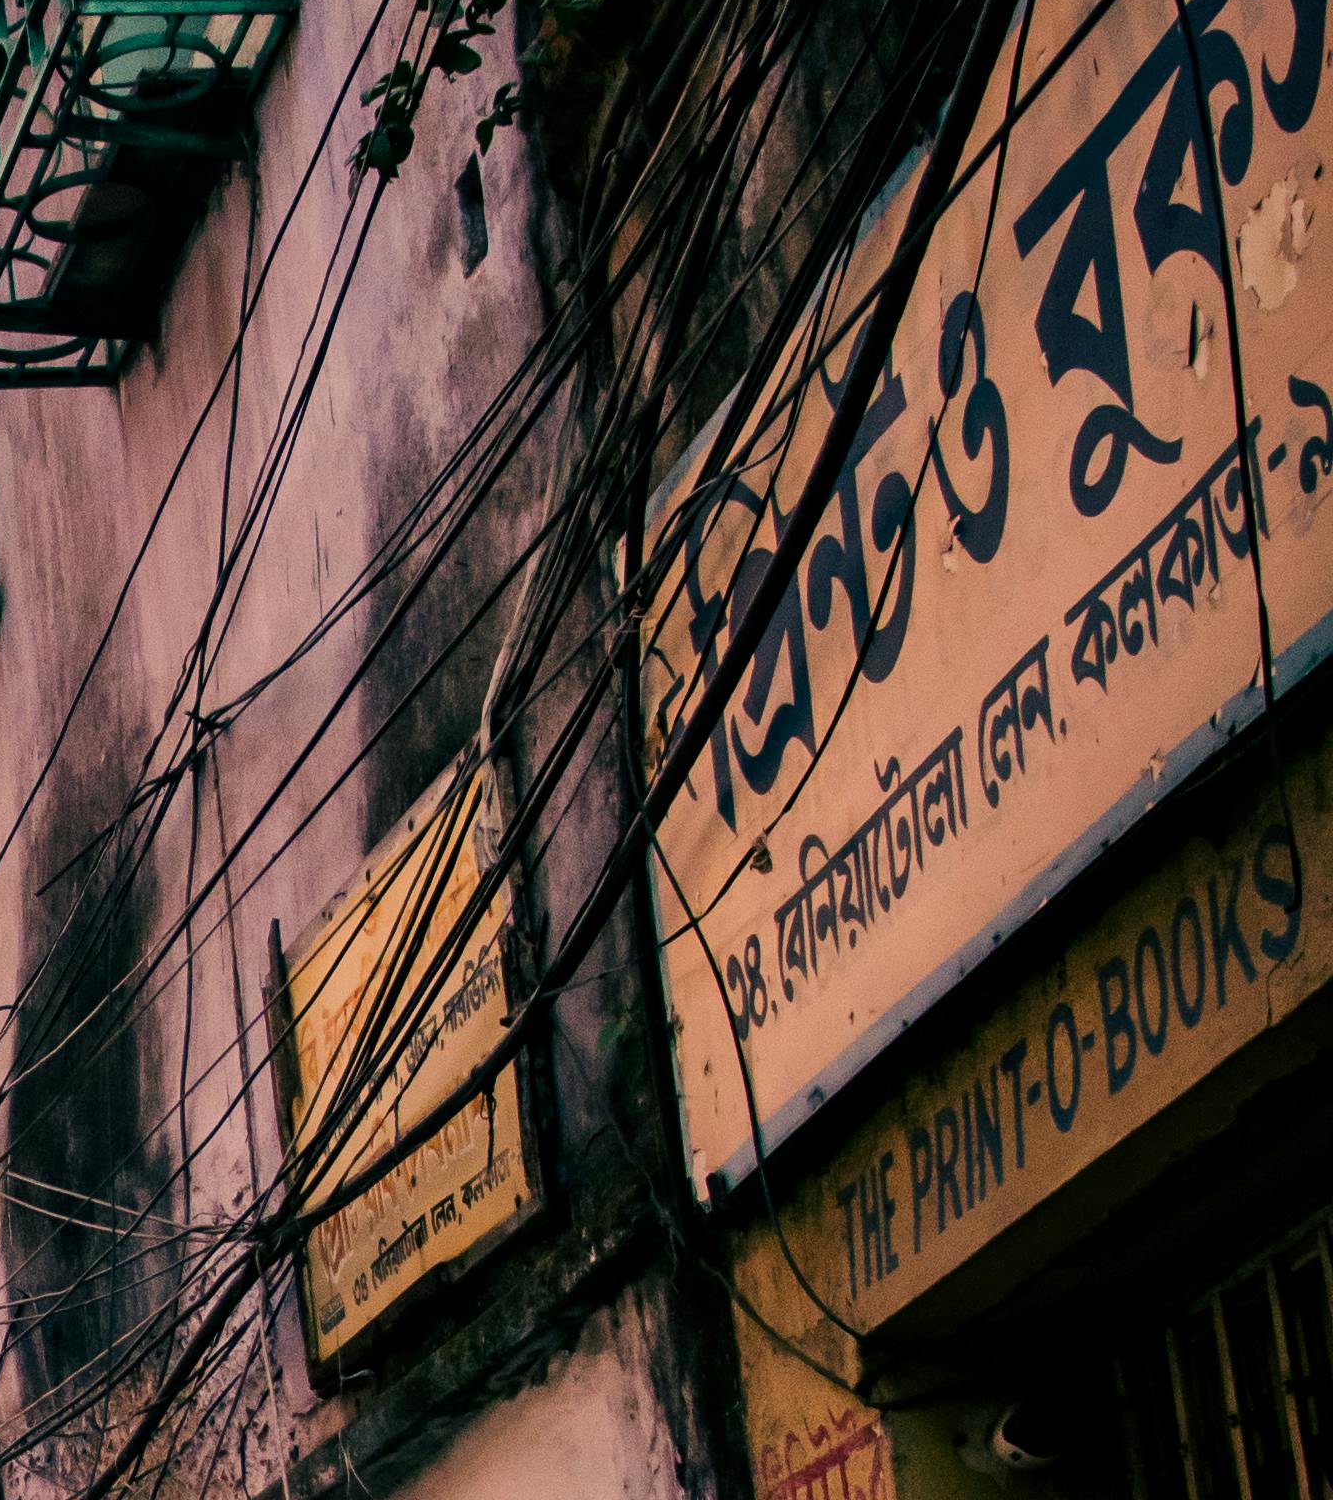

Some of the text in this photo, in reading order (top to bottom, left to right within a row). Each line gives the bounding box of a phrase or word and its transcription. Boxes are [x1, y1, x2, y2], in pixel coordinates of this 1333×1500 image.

[930, 291, 1009, 564] ও
[774, 726, 968, 1002] বেনিয়াটোলা
[838, 825, 1301, 1301] THE PRINT-O-BOOKS
